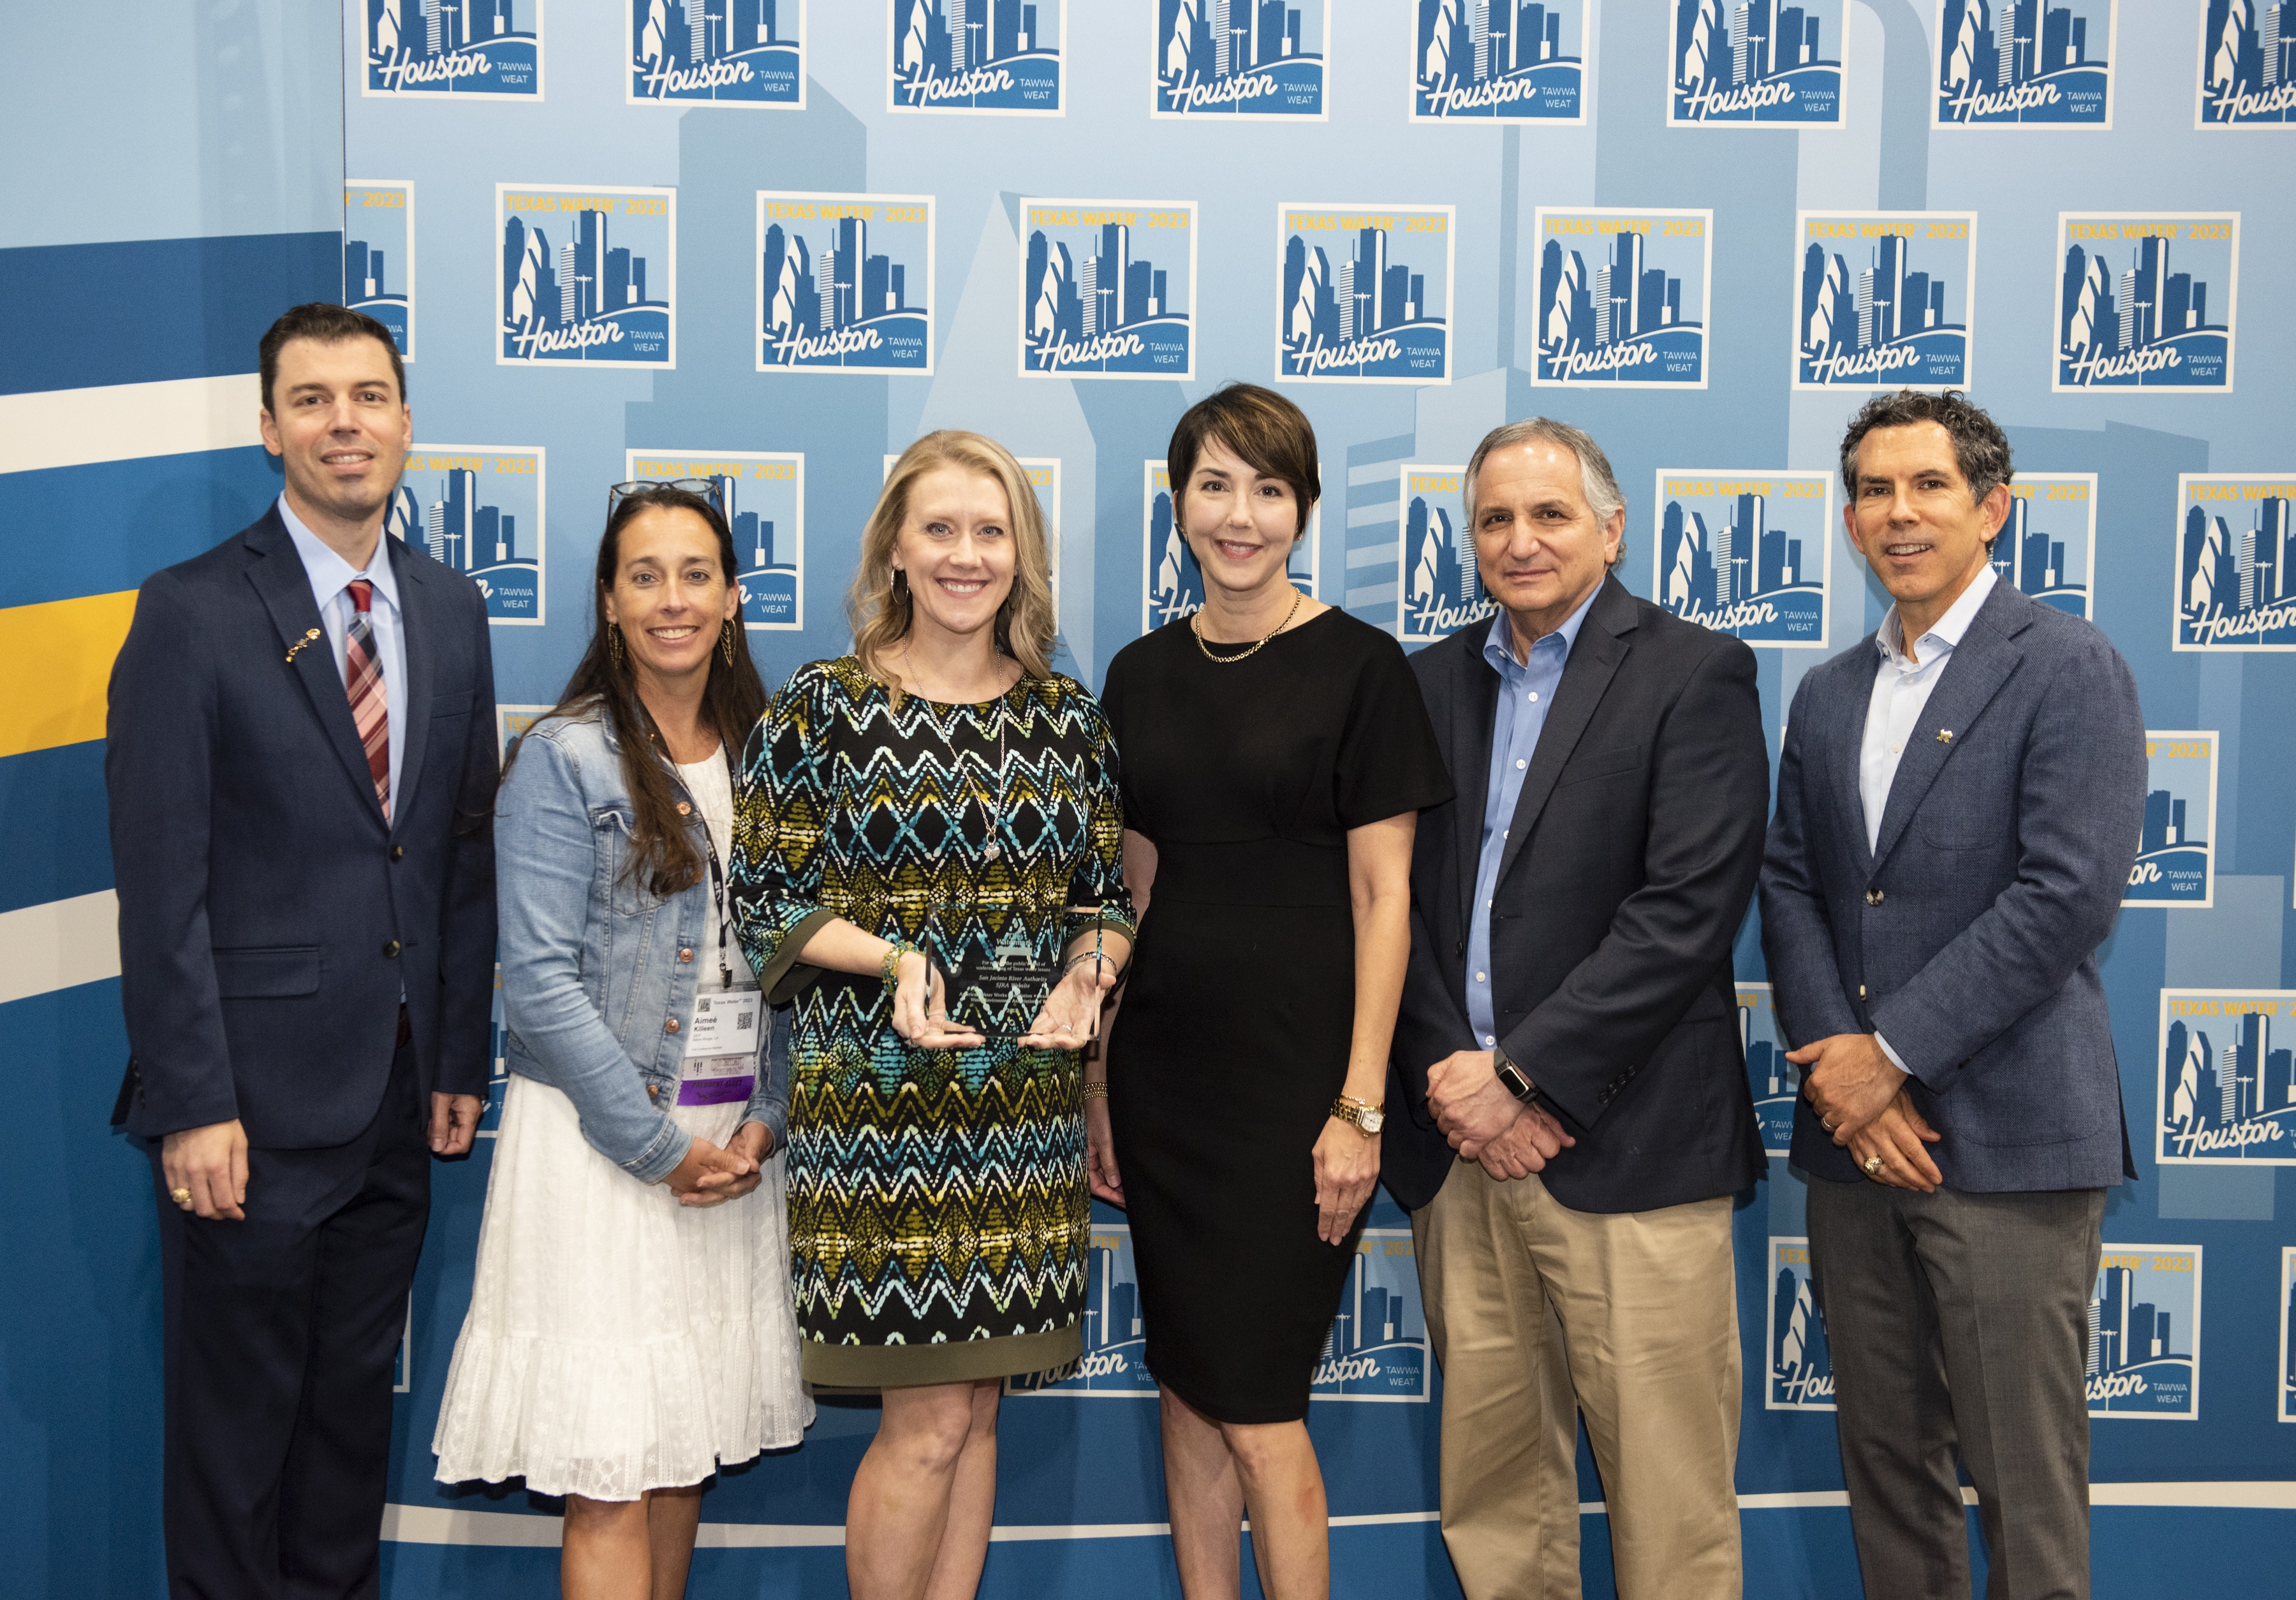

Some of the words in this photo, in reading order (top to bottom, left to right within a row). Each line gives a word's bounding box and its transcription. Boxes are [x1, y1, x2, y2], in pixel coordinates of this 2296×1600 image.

[378, 47, 492, 91] Houston
[497, 62, 533, 71] TAWWA
[501, 75, 528, 84] WEAT
[642, 55, 754, 99] Houston
[760, 71, 795, 80] TAWWA
[903, 63, 1014, 106] Houston
[1020, 78, 1054, 87] TAWWA
[764, 84, 790, 92] WEAT
[1166, 69, 1278, 113] Houston
[1283, 84, 1318, 92] TAWWA
[1542, 87, 1576, 96] TAWWA
[1024, 91, 1050, 100] WEAT
[1425, 73, 1536, 117] Houston
[1683, 77, 1795, 121] Houston
[1800, 91, 1836, 99] TAWWA
[2067, 92, 2102, 100] TAWWA
[1287, 96, 1313, 105] WEAT
[1545, 99, 1571, 108] WEAT
[1948, 78, 2061, 123] Houston
[1804, 103, 1830, 112] WEAT
[2071, 105, 2097, 113] WEAT
[363, 192, 404, 207] 2023
[506, 196, 556, 211] TEXAS
[626, 199, 666, 214] 2023
[766, 203, 816, 219] TEXAS
[885, 207, 926, 221] 2023
[1029, 210, 1078, 225] TEXAS
[1148, 213, 1188, 227] 2023
[1288, 215, 1336, 230] TEXAS
[1405, 217, 1446, 231] 2023
[1544, 219, 1593, 234] TEXAS
[1662, 221, 1703, 235] 2023
[1807, 223, 1857, 237] TEXAS
[1926, 224, 1968, 238] 2023
[2068, 224, 2118, 239] TEXAS
[2188, 224, 2230, 239] 2023
[513, 316, 624, 359] Houston
[629, 331, 665, 340] TAWWA
[772, 323, 883, 365] Houston
[888, 337, 922, 346] TAWWA
[634, 343, 660, 352] WEAT
[1034, 328, 1145, 371] Houston
[1150, 342, 1184, 351] TAWWA
[892, 350, 918, 358] WEAT
[1291, 333, 1401, 376] Houston
[1407, 348, 1441, 356] TAWWA
[1663, 351, 1697, 360] TAWWA
[1154, 355, 1180, 363] WEAT
[1547, 337, 1658, 381] Houston
[1809, 341, 1920, 384] Houston
[1926, 354, 1961, 362] TAWWA
[2188, 355, 2222, 363] TAWWA
[1410, 360, 1436, 368] WEAT
[2069, 342, 2182, 386] Houston
[1929, 367, 1955, 375] WEAT
[2191, 367, 2218, 376] WEAT
[494, 459, 536, 473] 2023
[636, 461, 685, 476] TEXAS
[754, 464, 795, 478] 2023
[1409, 476, 1459, 492] TEXAS
[1665, 481, 1714, 495] TEXAS
[1783, 483, 1823, 497] 2023
[2046, 485, 2087, 499] 2023
[2188, 485, 2239, 499] TEXAS
[499, 587, 533, 596] TAWWA
[758, 593, 792, 601] TAWWA
[503, 600, 529, 608] WEAT
[762, 605, 788, 613] WEAT
[1784, 611, 1818, 619] TAWWA
[1787, 623, 1813, 631] WEAT
[2168, 742, 2209, 756] 2023
[2170, 1001, 2219, 1015] TEXAS
[694, 1016, 718, 1024] Aimeé
[2172, 1116, 2284, 1158] Houston
[1384, 1240, 1414, 1256] 202
[2152, 1256, 2193, 1270] 2023
[1386, 1366, 1419, 1374] TAWWA
[2153, 1383, 2188, 1391] TAWWA
[2157, 1395, 2182, 1404] WEAT
